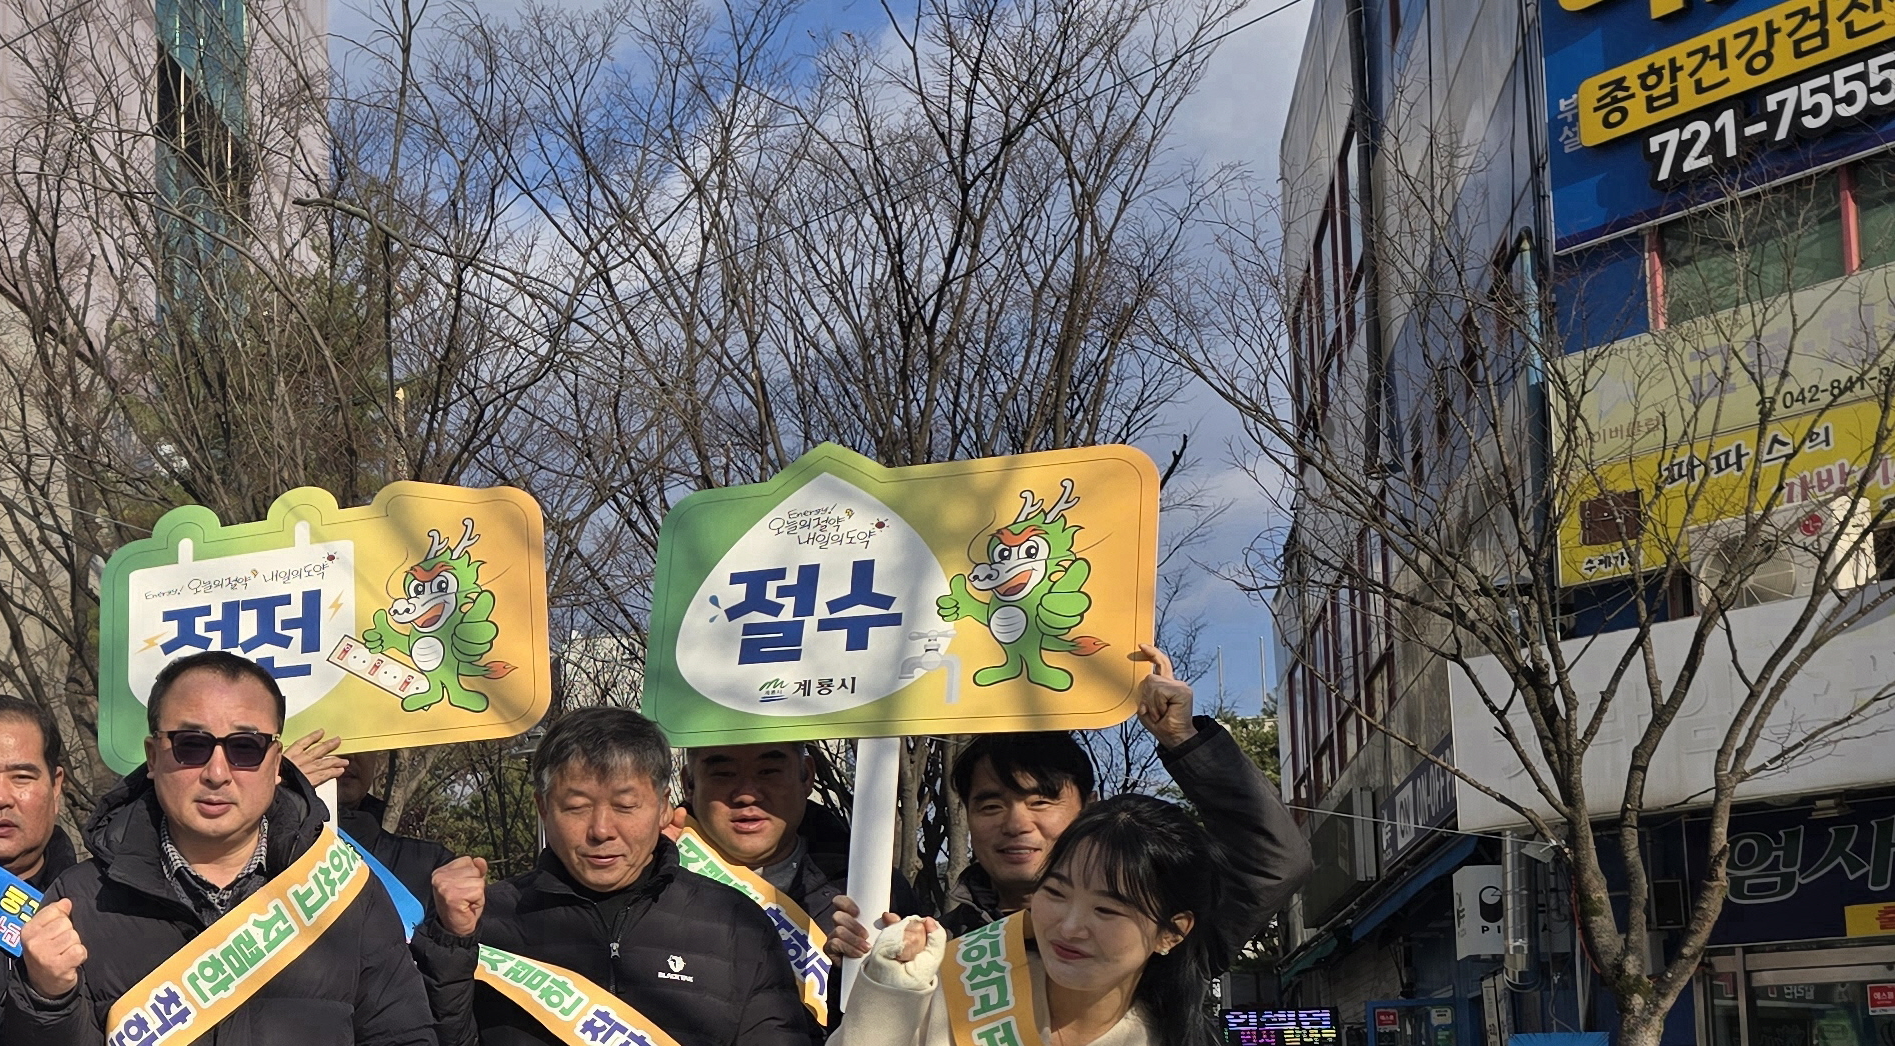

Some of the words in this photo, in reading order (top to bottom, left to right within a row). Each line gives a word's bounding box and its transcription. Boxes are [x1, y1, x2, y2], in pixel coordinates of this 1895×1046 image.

[1650, 52, 1895, 182] 721-7555
[724, 558, 902, 665] 절수
[792, 677, 856, 697] 계룡시
[189, 904, 295, 1003] 저렴한
